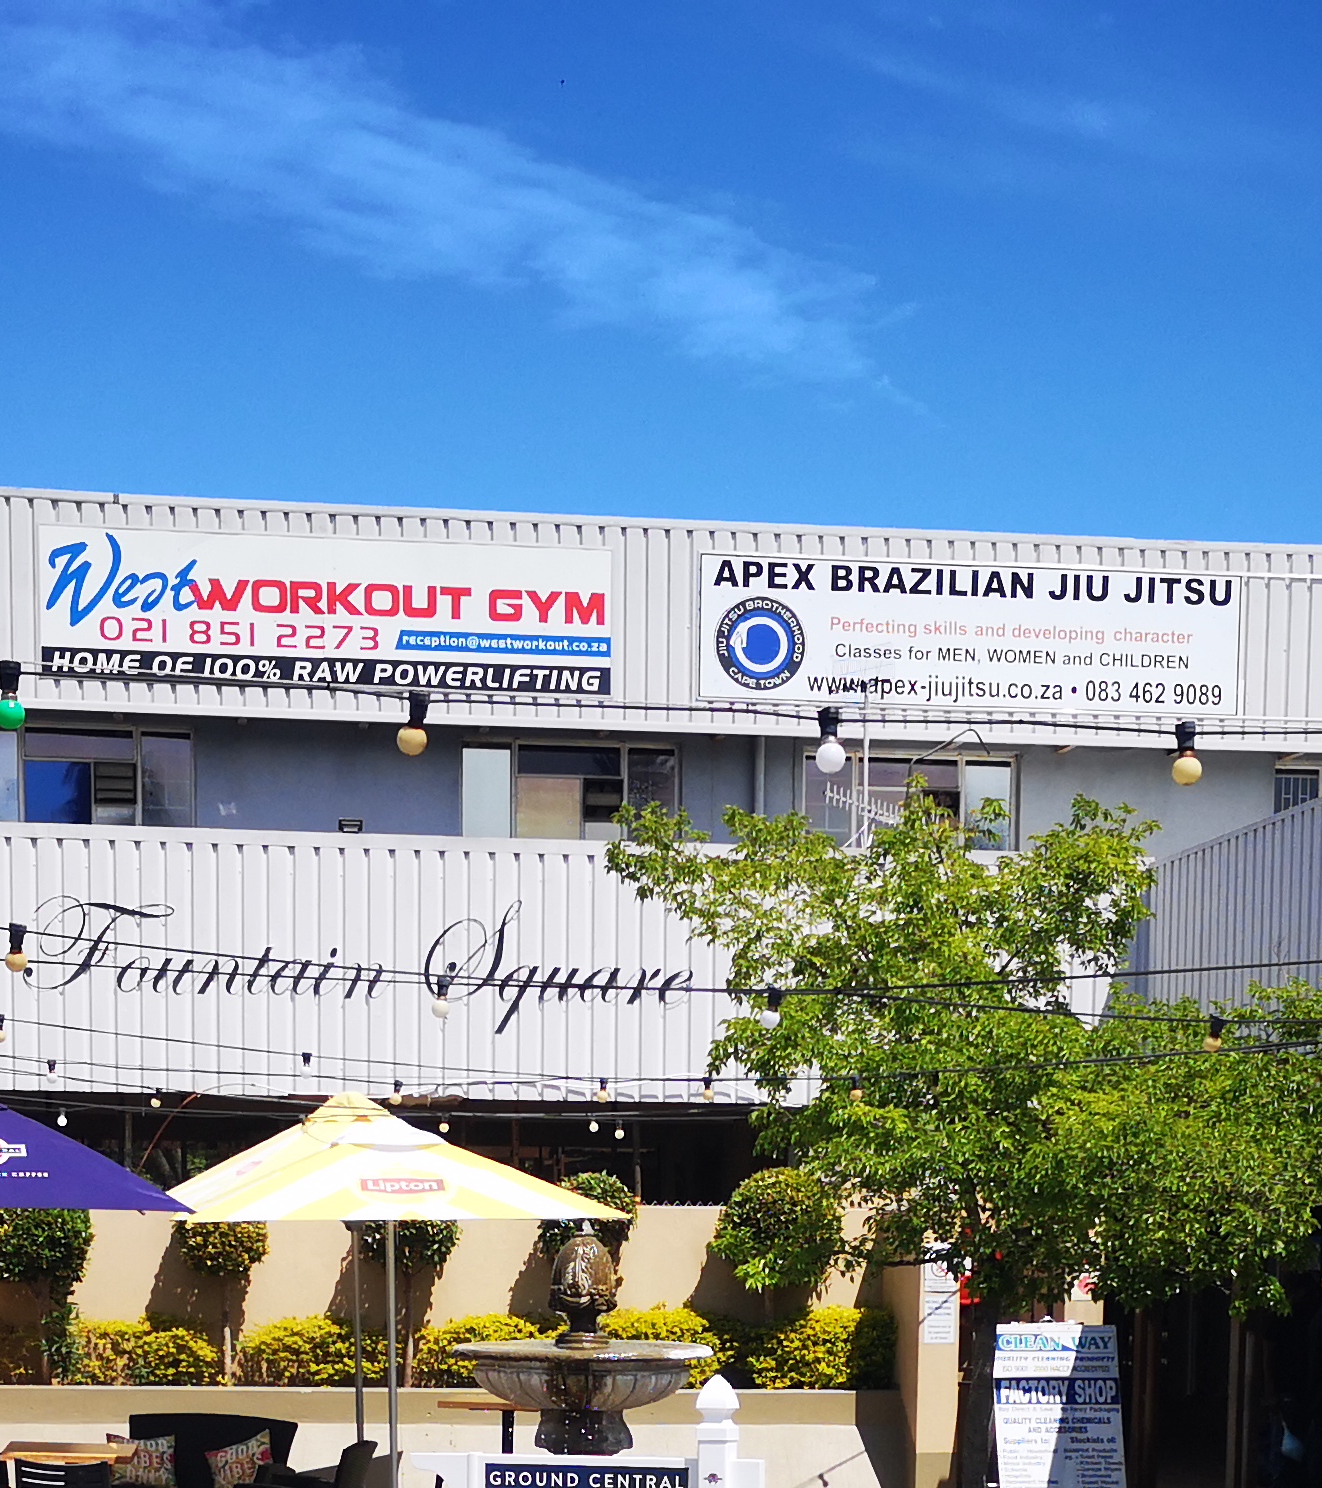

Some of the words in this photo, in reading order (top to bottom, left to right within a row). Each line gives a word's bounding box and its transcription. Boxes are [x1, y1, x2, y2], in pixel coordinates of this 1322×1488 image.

[46, 533, 198, 627] West
[190, 577, 472, 620] WORKOUT
[488, 588, 605, 626] GYM
[713, 559, 817, 592] APEX
[830, 564, 1036, 600] BRAZILIAN
[1048, 573, 1110, 602] JIU
[1122, 575, 1234, 607] JITSU
[99, 616, 167, 644] 021
[189, 620, 256, 648] 851
[276, 623, 380, 652] 2273
[720, 605, 745, 636] JITSU
[745, 600, 803, 662] BROTHERHOOD
[830, 616, 918, 638] Perfecting
[923, 619, 968, 637] skills
[974, 621, 1007, 638] and
[1011, 623, 1106, 644] developing
[1113, 627, 1194, 644] character
[401, 632, 608, 653] reception@westworkout.co.za
[718, 637, 729, 657] JIU
[834, 643, 903, 661] Classes
[907, 645, 933, 661] for
[938, 647, 981, 666] MEN,
[987, 648, 1056, 666] WOMEN
[1062, 651, 1094, 667] and
[1098, 653, 1189, 670] CHILDREN
[51, 651, 142, 675] HOME
[153, 655, 193, 677] OF
[203, 657, 281, 682] 100%
[293, 659, 365, 684] RAW
[373, 662, 601, 692] POWERLIFTING
[729, 667, 756, 688] CAPE
[758, 669, 791, 688] TOWN
[807, 672, 1064, 703] wwwapex-jiujitsu.co.za
[1084, 680, 1122, 702] 083
[1128, 681, 1166, 703] 462
[1173, 682, 1222, 705] 9089
[22, 895, 394, 1000] Fountain
[424, 900, 695, 1034] Square
[367, 1178, 439, 1193] Lipton
[998, 1334, 1062, 1351] CLEAN
[1071, 1336, 1111, 1350] WAY
[999, 1380, 1068, 1404] FACTORY
[1074, 1380, 1117, 1403] SHOP
[1003, 1417, 1032, 1425] QUALITY
[1035, 1417, 1069, 1425] CLEANING
[1072, 1417, 1111, 1425] CHEMICALS
[489, 1471, 579, 1488] GROUND
